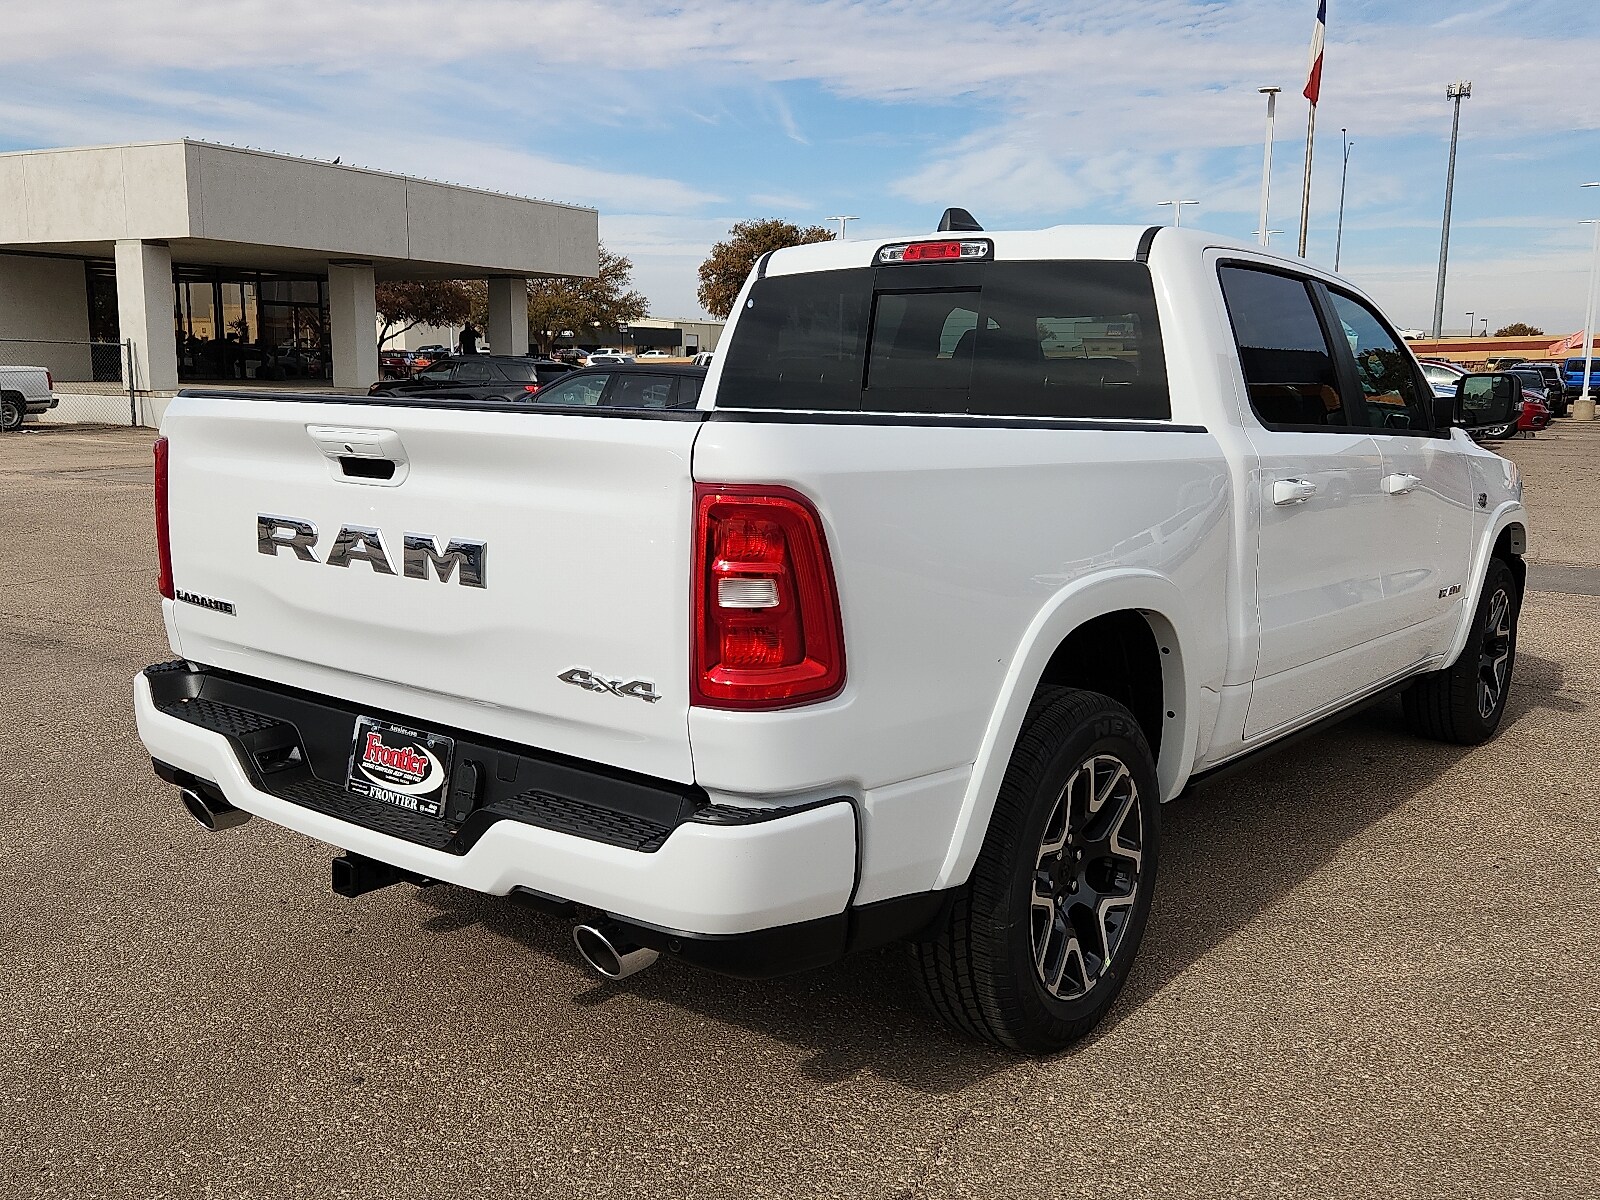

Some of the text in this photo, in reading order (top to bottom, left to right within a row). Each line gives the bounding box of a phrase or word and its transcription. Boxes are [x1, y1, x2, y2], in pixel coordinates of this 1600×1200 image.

[257, 512, 487, 589] RAM
[363, 732, 429, 776] Frontier
[369, 786, 418, 811] FRONTIER
